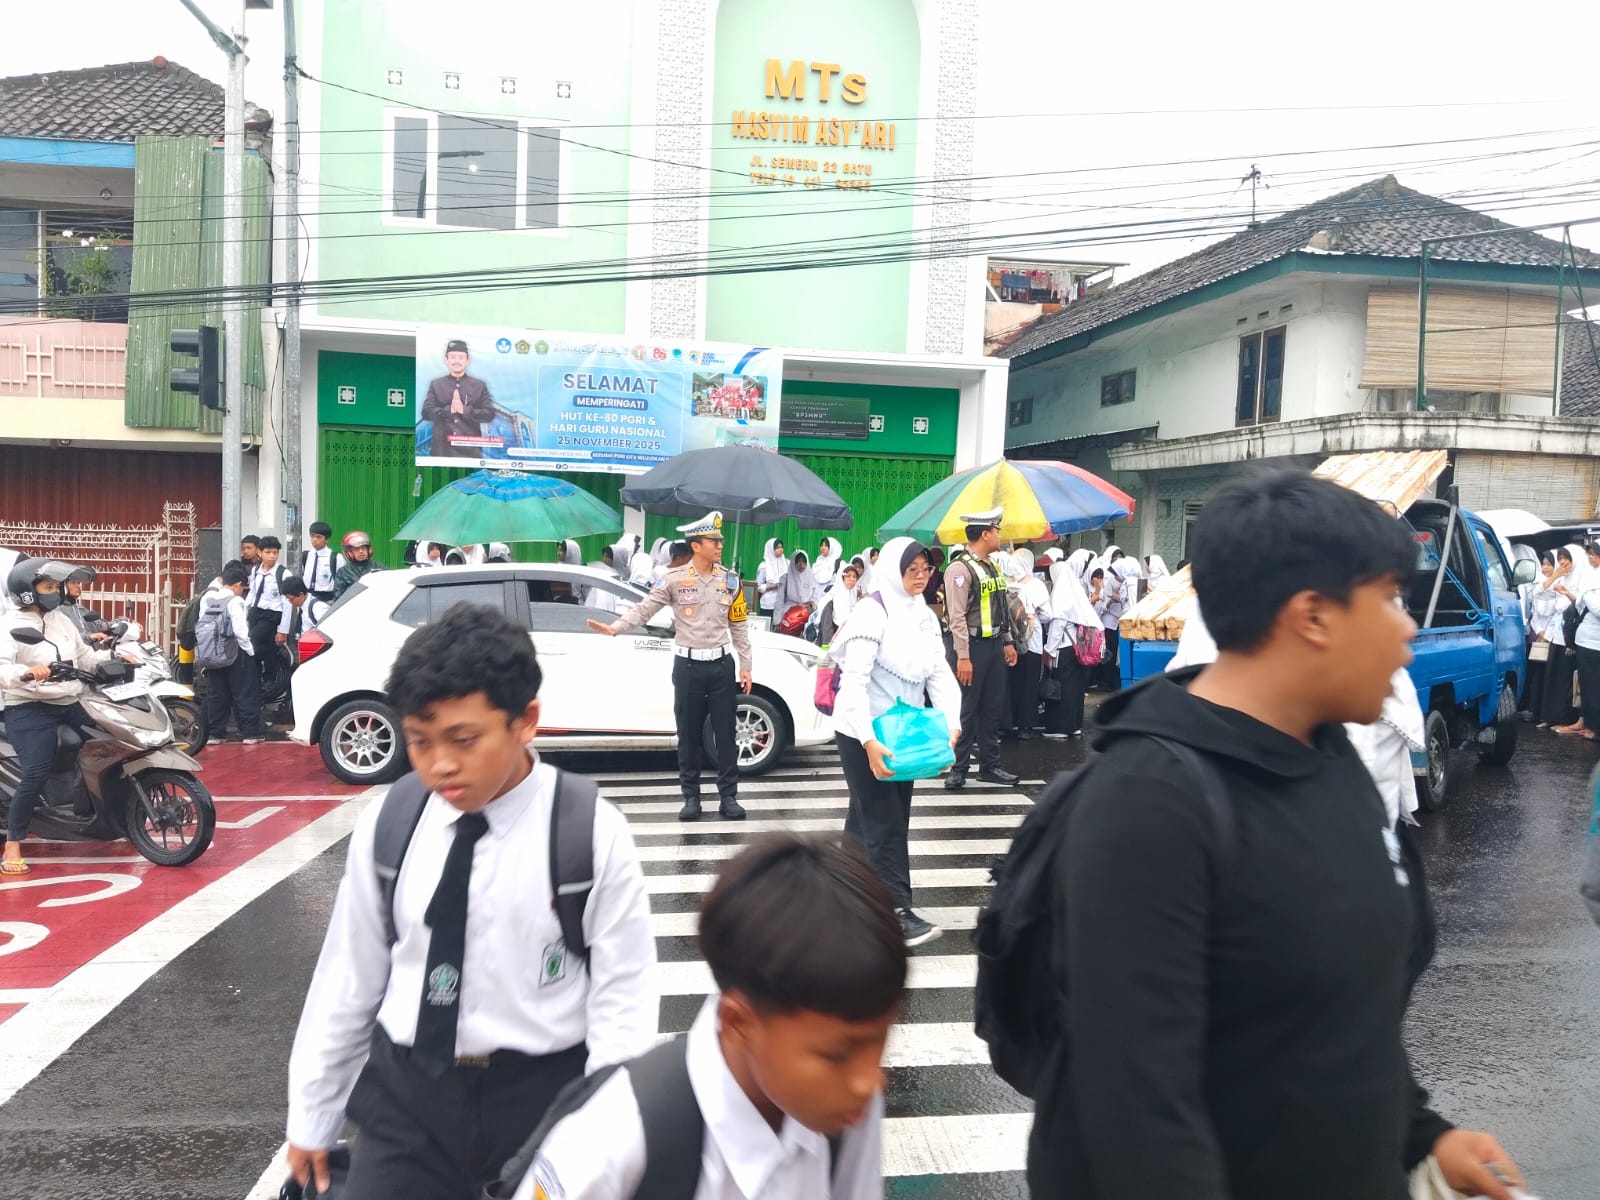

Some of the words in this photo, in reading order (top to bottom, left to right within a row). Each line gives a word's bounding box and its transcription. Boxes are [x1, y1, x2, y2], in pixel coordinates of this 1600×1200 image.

[765, 57, 868, 105] MTs
[732, 109, 810, 144] HASYIM
[815, 117, 897, 151] ASY'ARI
[750, 154, 768, 168] JL.
[771, 157, 819, 172] SEMERU
[823, 160, 838, 174] 22
[843, 162, 873, 176] BATU
[563, 372, 659, 394] SELAMAT
[576, 397, 645, 409] MEMPERINGATI
[560, 411, 584, 421] HUT
[585, 412, 618, 423] KE-80
[620, 415, 646, 425] PGRI
[647, 416, 657, 426] &
[550, 423, 577, 433] HARI
[580, 424, 609, 434] GURU
[610, 426, 666, 438] NASIONAL
[557, 436, 571, 446] 25
[573, 437, 632, 449] NOVEMBER
[634, 440, 661, 450] 2025
